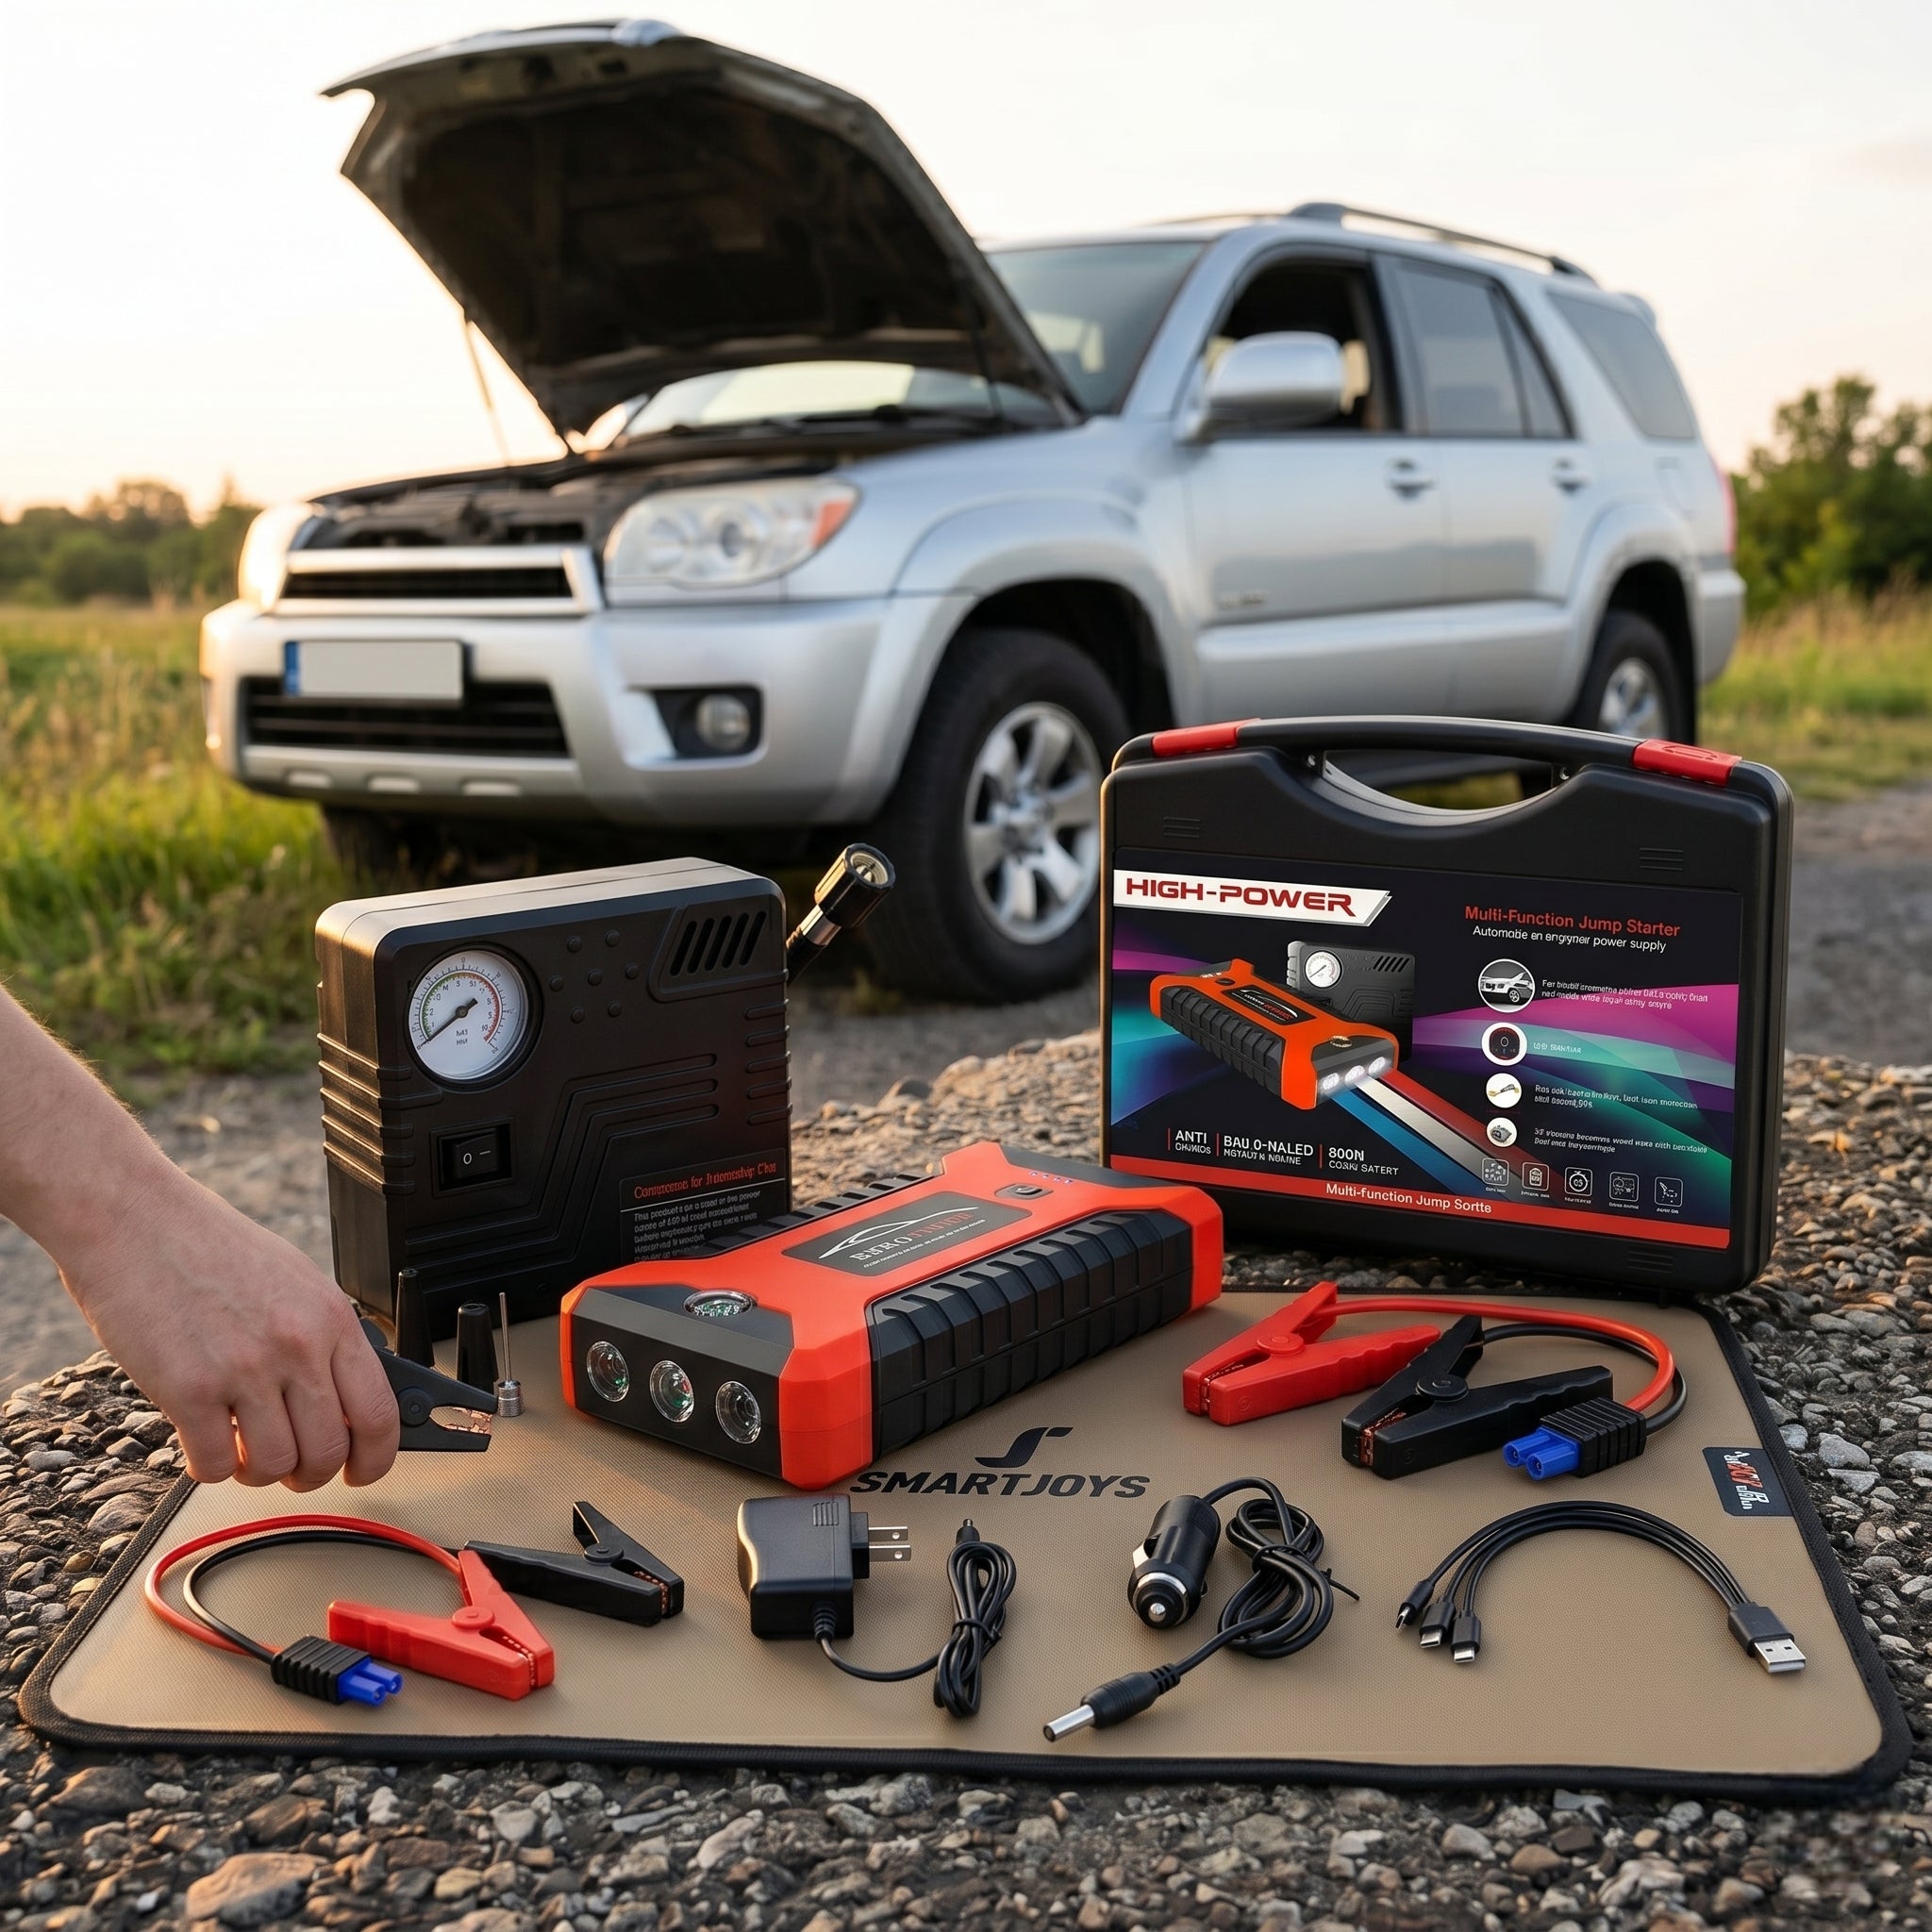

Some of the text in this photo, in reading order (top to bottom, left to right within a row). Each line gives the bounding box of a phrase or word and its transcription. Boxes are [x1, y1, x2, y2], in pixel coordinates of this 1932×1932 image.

[1126, 878, 1357, 917] HIGH-POWER
[1465, 906, 1680, 937] Multi-Function Jump Starter
[1593, 937, 1626, 948] power
[1630, 940, 1667, 953] supply
[1175, 1130, 1207, 1144] ANTI
[1326, 1182, 1492, 1213] Multi-function Jump Sortts
[849, 1471, 1151, 1498] SMARTJOYS
